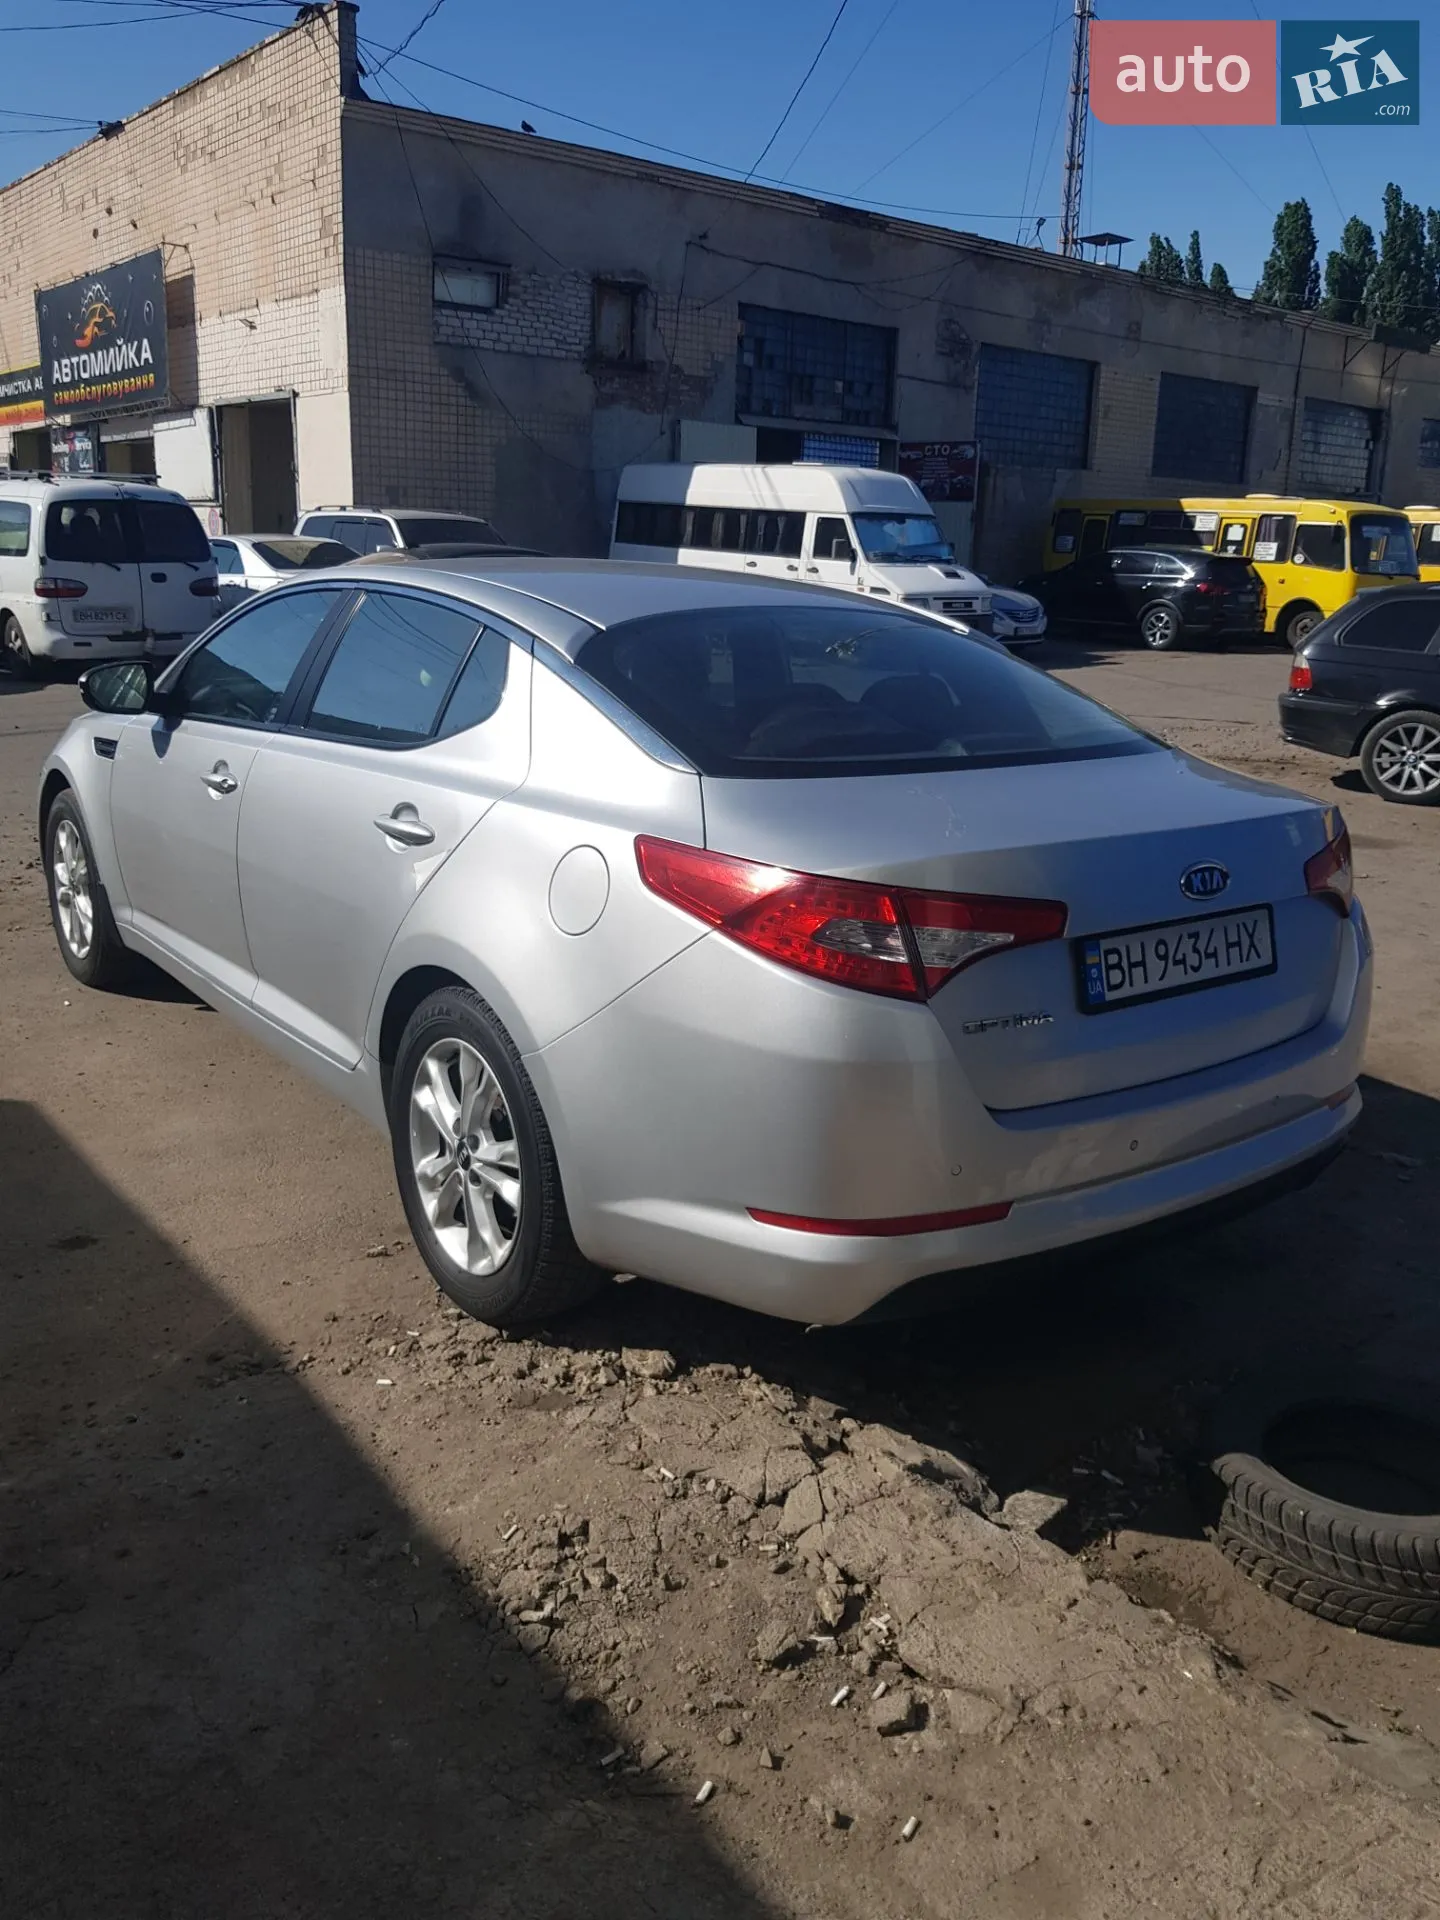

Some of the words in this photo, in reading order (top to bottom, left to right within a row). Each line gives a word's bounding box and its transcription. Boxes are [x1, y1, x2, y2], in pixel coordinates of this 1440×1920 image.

[52, 337, 154, 385] АВТОМИЙКА
[53, 372, 156, 405] самообслуговування
[1190, 870, 1224, 893] KIA
[1103, 941, 1148, 992] BH
[1154, 928, 1219, 981] 9434
[1224, 919, 1262, 967] HX
[1088, 981, 1103, 995] UA
